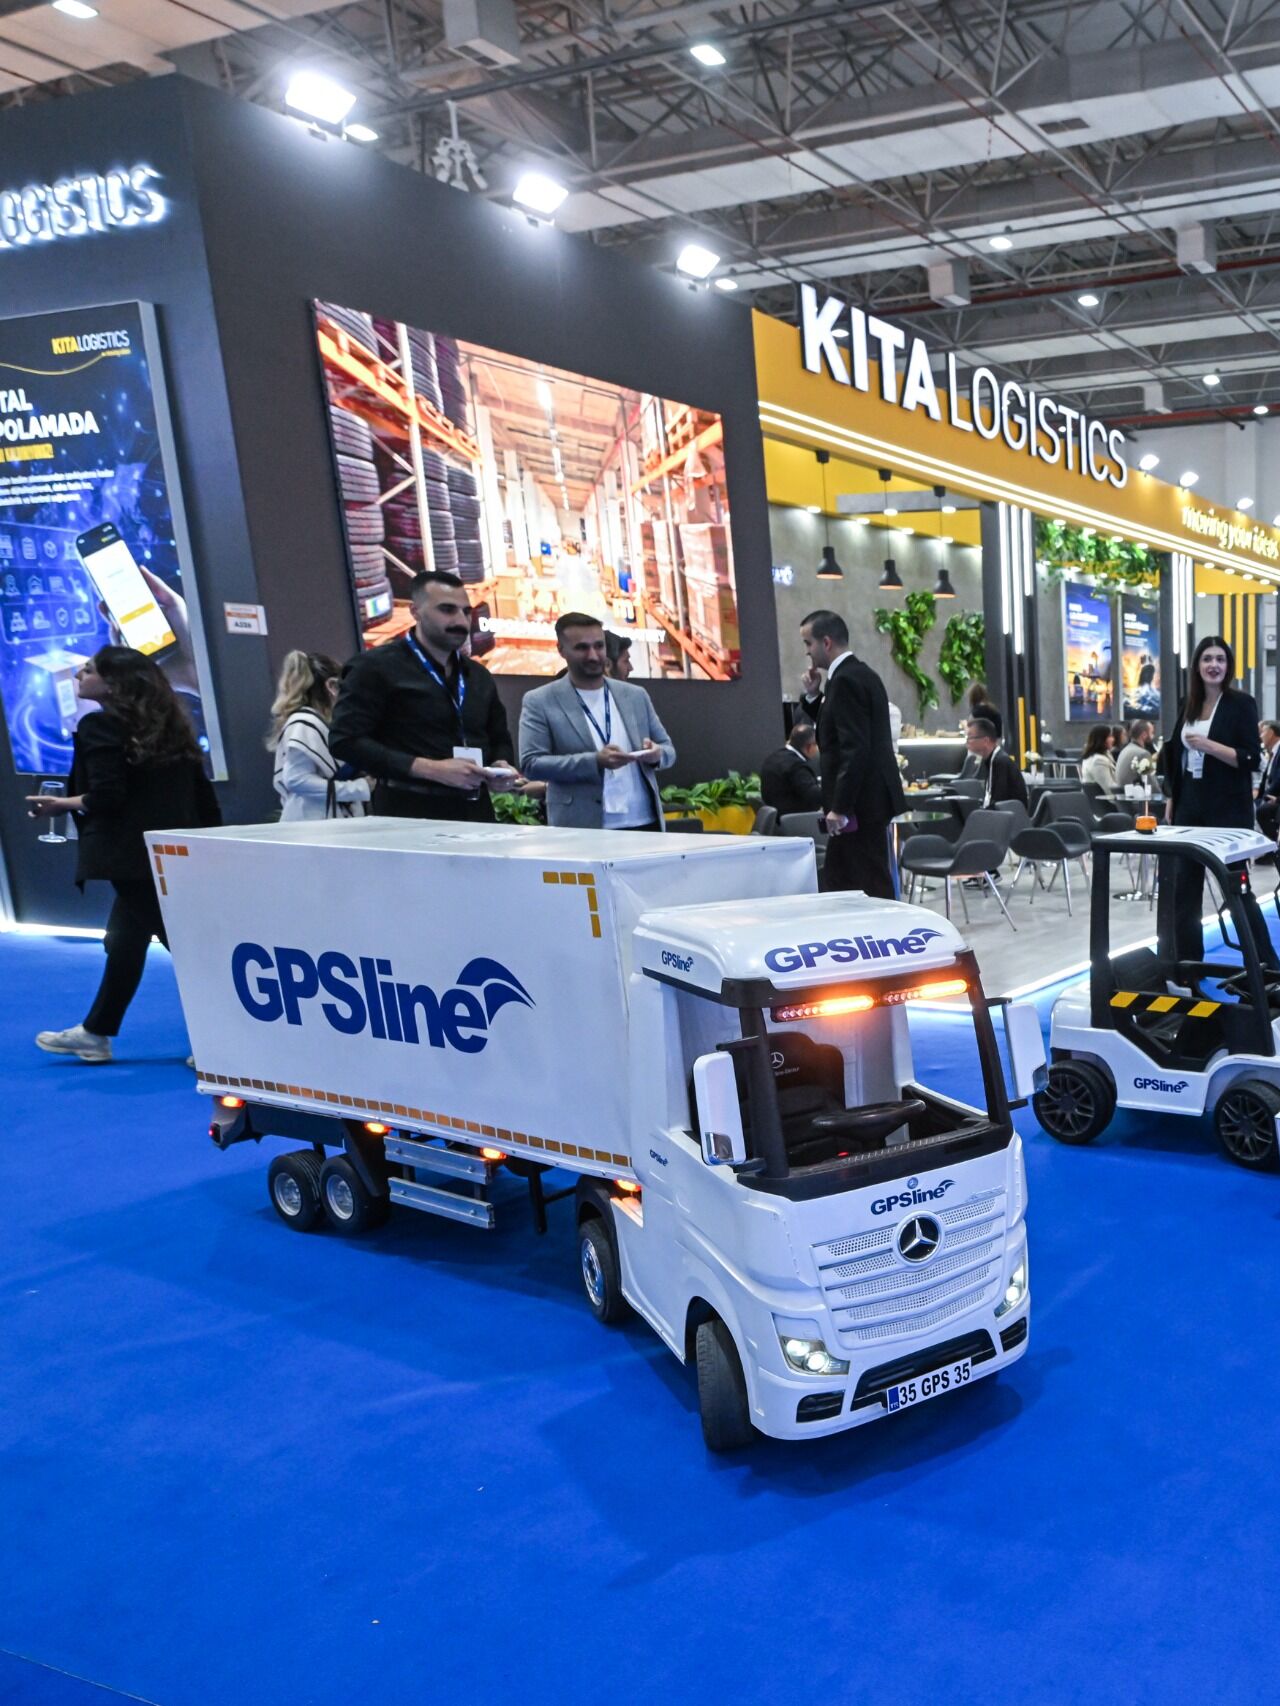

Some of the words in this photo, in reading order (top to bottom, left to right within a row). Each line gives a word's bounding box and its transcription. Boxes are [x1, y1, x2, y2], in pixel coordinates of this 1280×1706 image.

[800, 283, 942, 421] KITA
[947, 350, 1130, 489] LOGISTICS
[1181, 505, 1228, 550] moving
[661, 949, 692, 972] GPSline
[764, 933, 928, 974] GPSline
[231, 941, 489, 1054] GPSline
[1134, 1077, 1183, 1094] GPSline
[870, 1186, 946, 1216] GPSline
[900, 1383, 917, 1406] 35
[921, 1370, 951, 1397] GPS
[954, 1362, 971, 1385] 35
